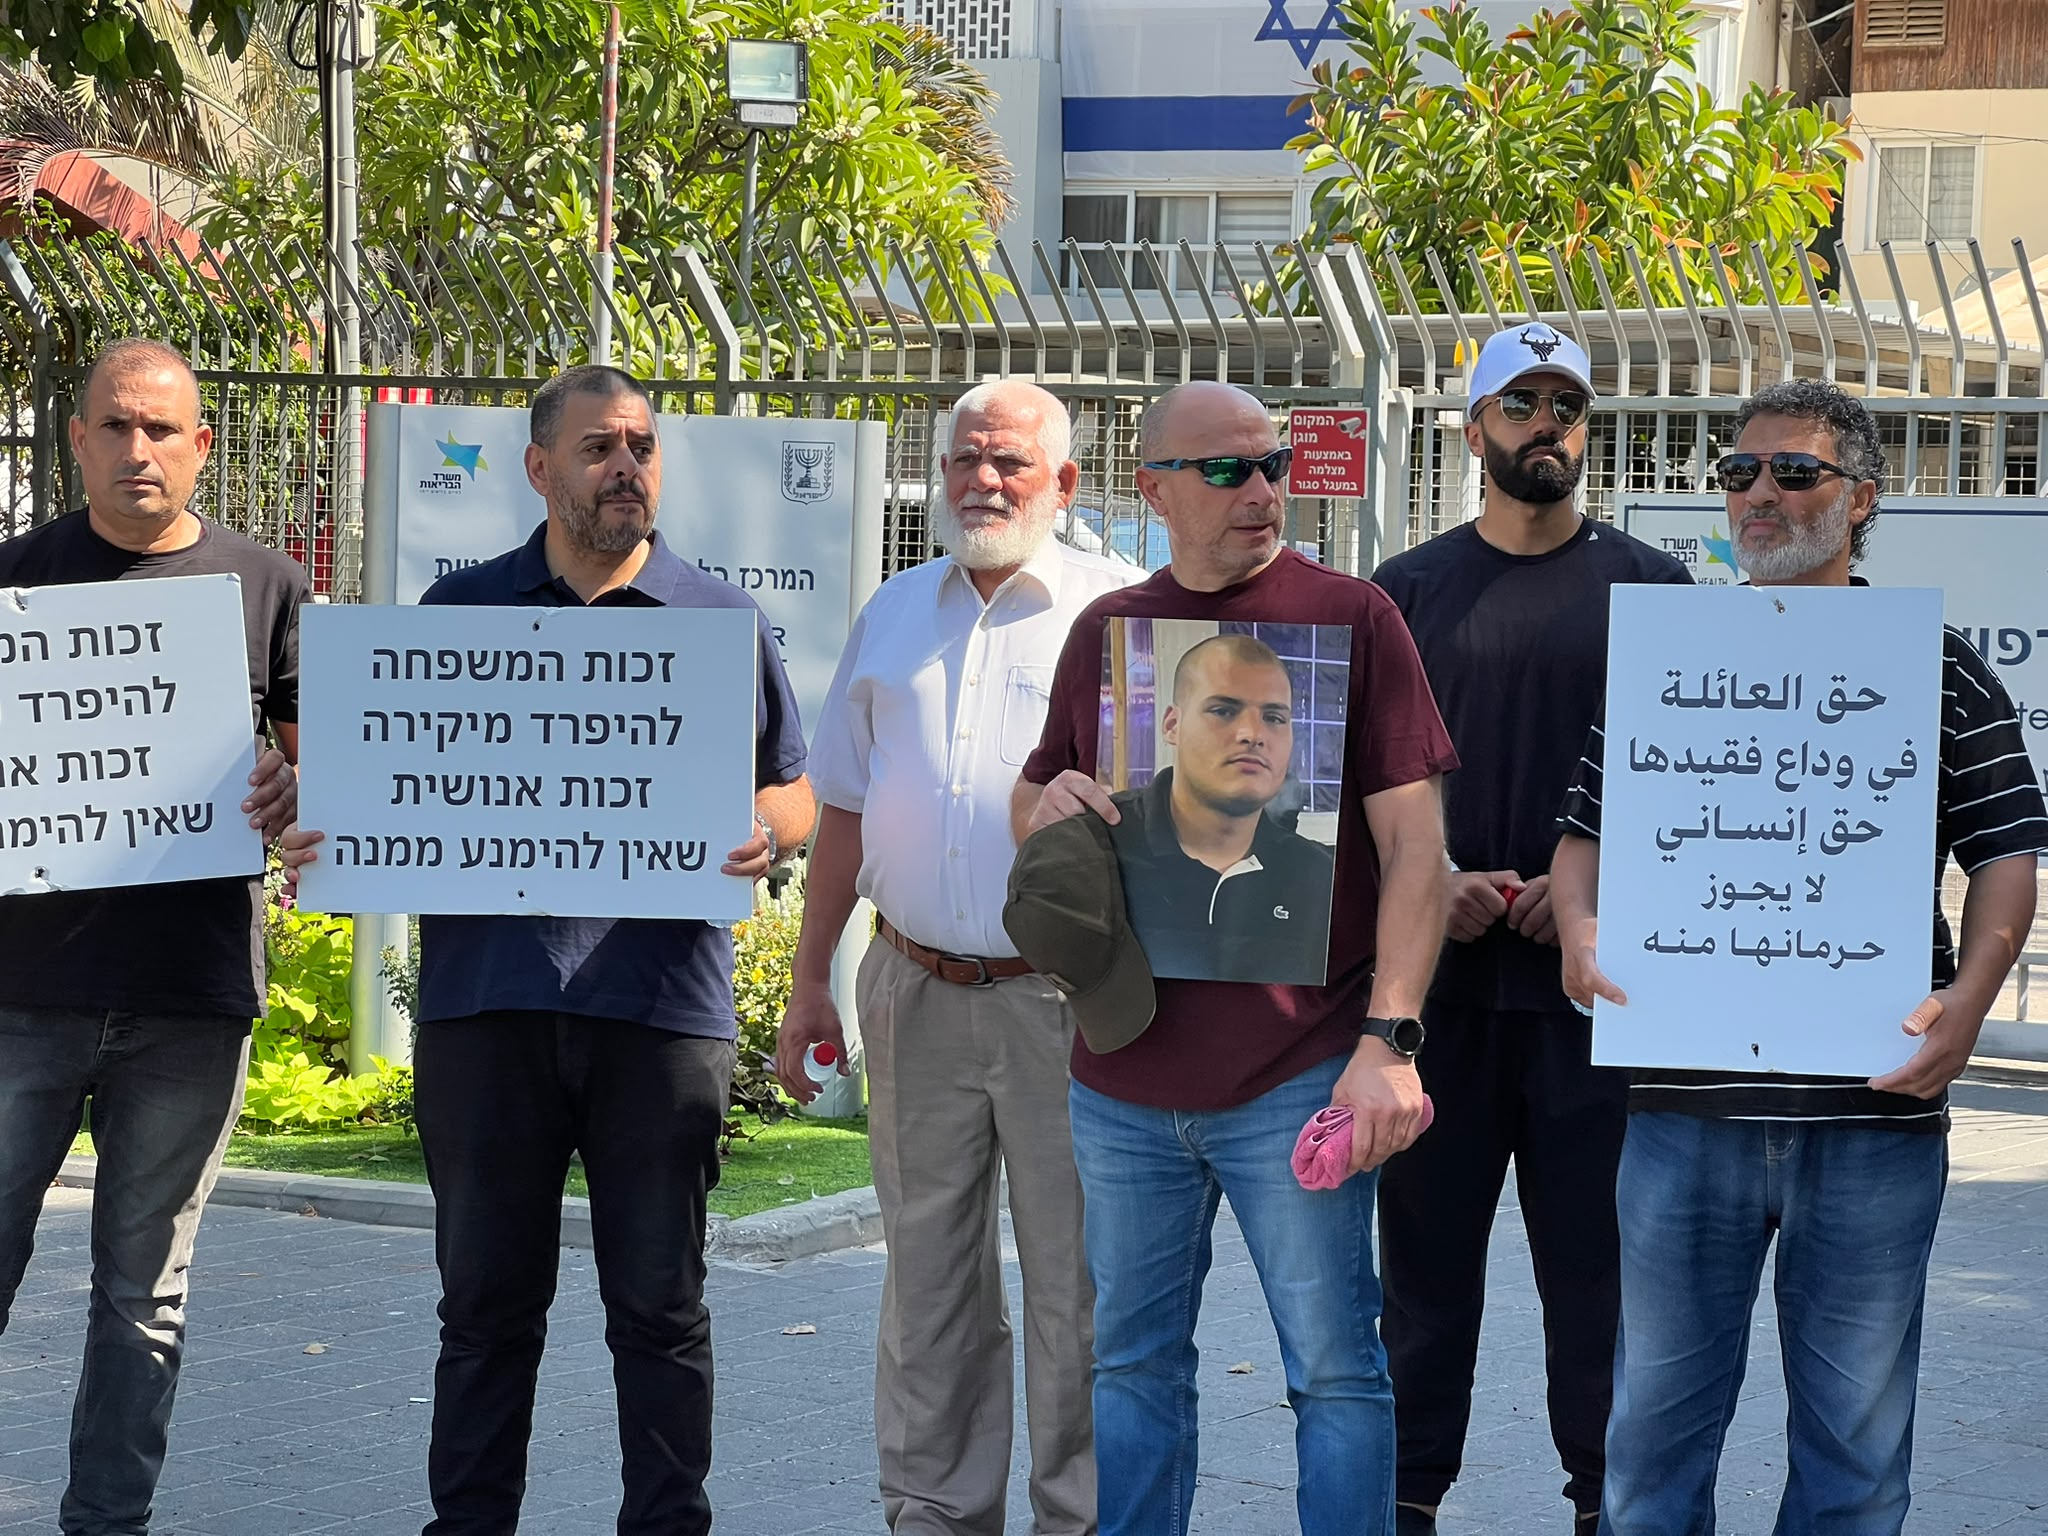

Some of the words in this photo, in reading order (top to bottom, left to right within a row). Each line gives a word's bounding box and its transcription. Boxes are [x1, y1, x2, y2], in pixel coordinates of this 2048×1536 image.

[1293, 415, 1334, 428] המקום
[1293, 432, 1318, 446] מוגן
[1304, 450, 1352, 460] באמצעות
[420, 480, 461, 489] הבריאות
[433, 473, 461, 481] משרד
[1296, 480, 1319, 489] סגור
[1309, 463, 1346, 475] מצלמה
[1323, 479, 1358, 490] במעגל
[793, 487, 824, 499] ישראל
[1660, 538, 1698, 550] משרד
[739, 567, 815, 591] המרכז
[69, 623, 162, 658] זכות
[373, 649, 563, 681] המשפחה
[583, 652, 675, 682] זכות
[19, 676, 175, 722] להיפרד
[1661, 669, 1802, 710] العائلة
[1817, 675, 1886, 724] حق
[364, 711, 511, 752] מיקירה
[531, 707, 682, 745] להיפרד
[57, 747, 150, 783] זכות
[1630, 736, 1761, 785] فقيدها
[1775, 741, 1853, 792] وداع
[1868, 739, 1917, 802] في
[391, 774, 542, 806] אנושית
[560, 777, 652, 808] זכות
[123, 803, 213, 848] שאין
[1656, 805, 1807, 862] إنساني
[1820, 808, 1883, 855] حق
[336, 836, 442, 866] ממנה
[460, 832, 604, 869] להימנע
[619, 840, 706, 880] שאין
[1701, 874, 1791, 912] يجوز
[1805, 873, 1825, 902] لا
[1644, 928, 1715, 954] منه
[1731, 928, 1885, 969] حرمانها
